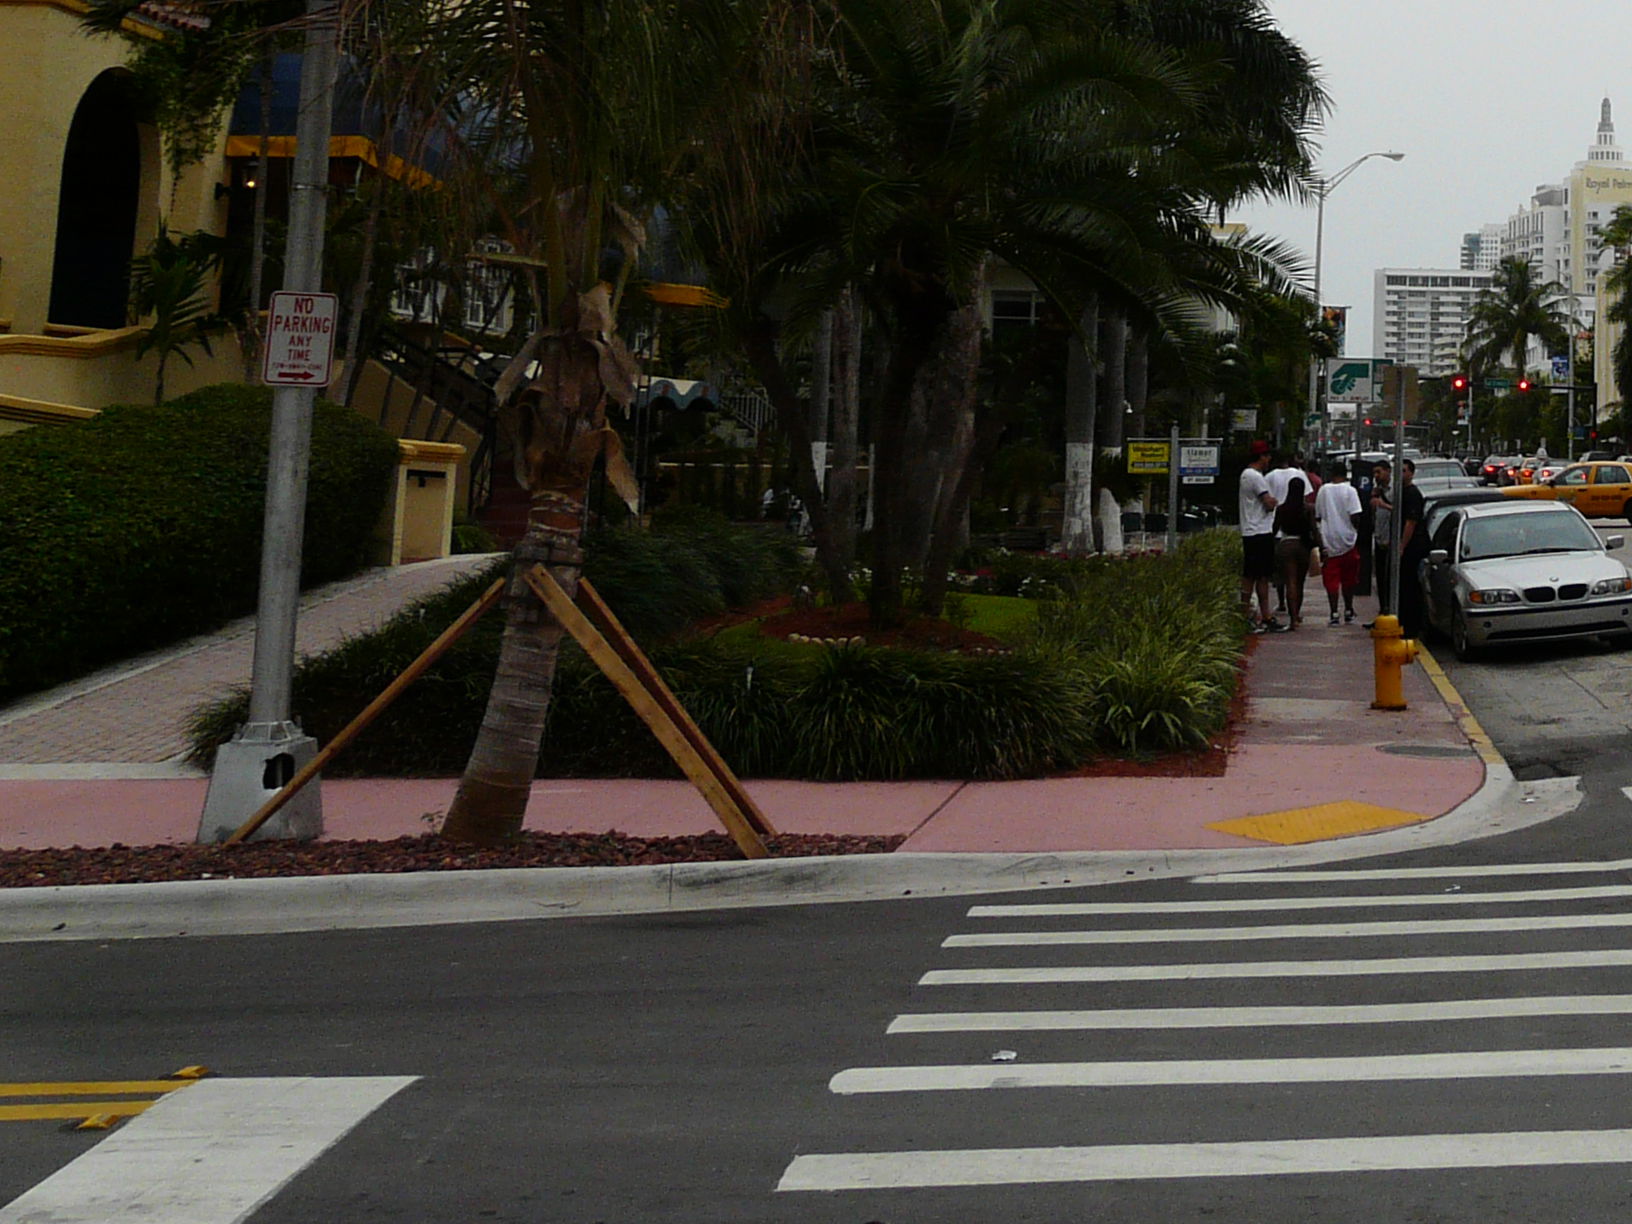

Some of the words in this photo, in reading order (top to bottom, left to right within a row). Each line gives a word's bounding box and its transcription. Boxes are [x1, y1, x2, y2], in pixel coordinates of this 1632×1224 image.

[1586, 177, 1610, 194] Royal
[294, 297, 314, 314] NO
[274, 315, 331, 334] PARKING
[288, 335, 313, 347] ANY
[287, 349, 313, 361] TIME
[1359, 476, 1370, 489] P
